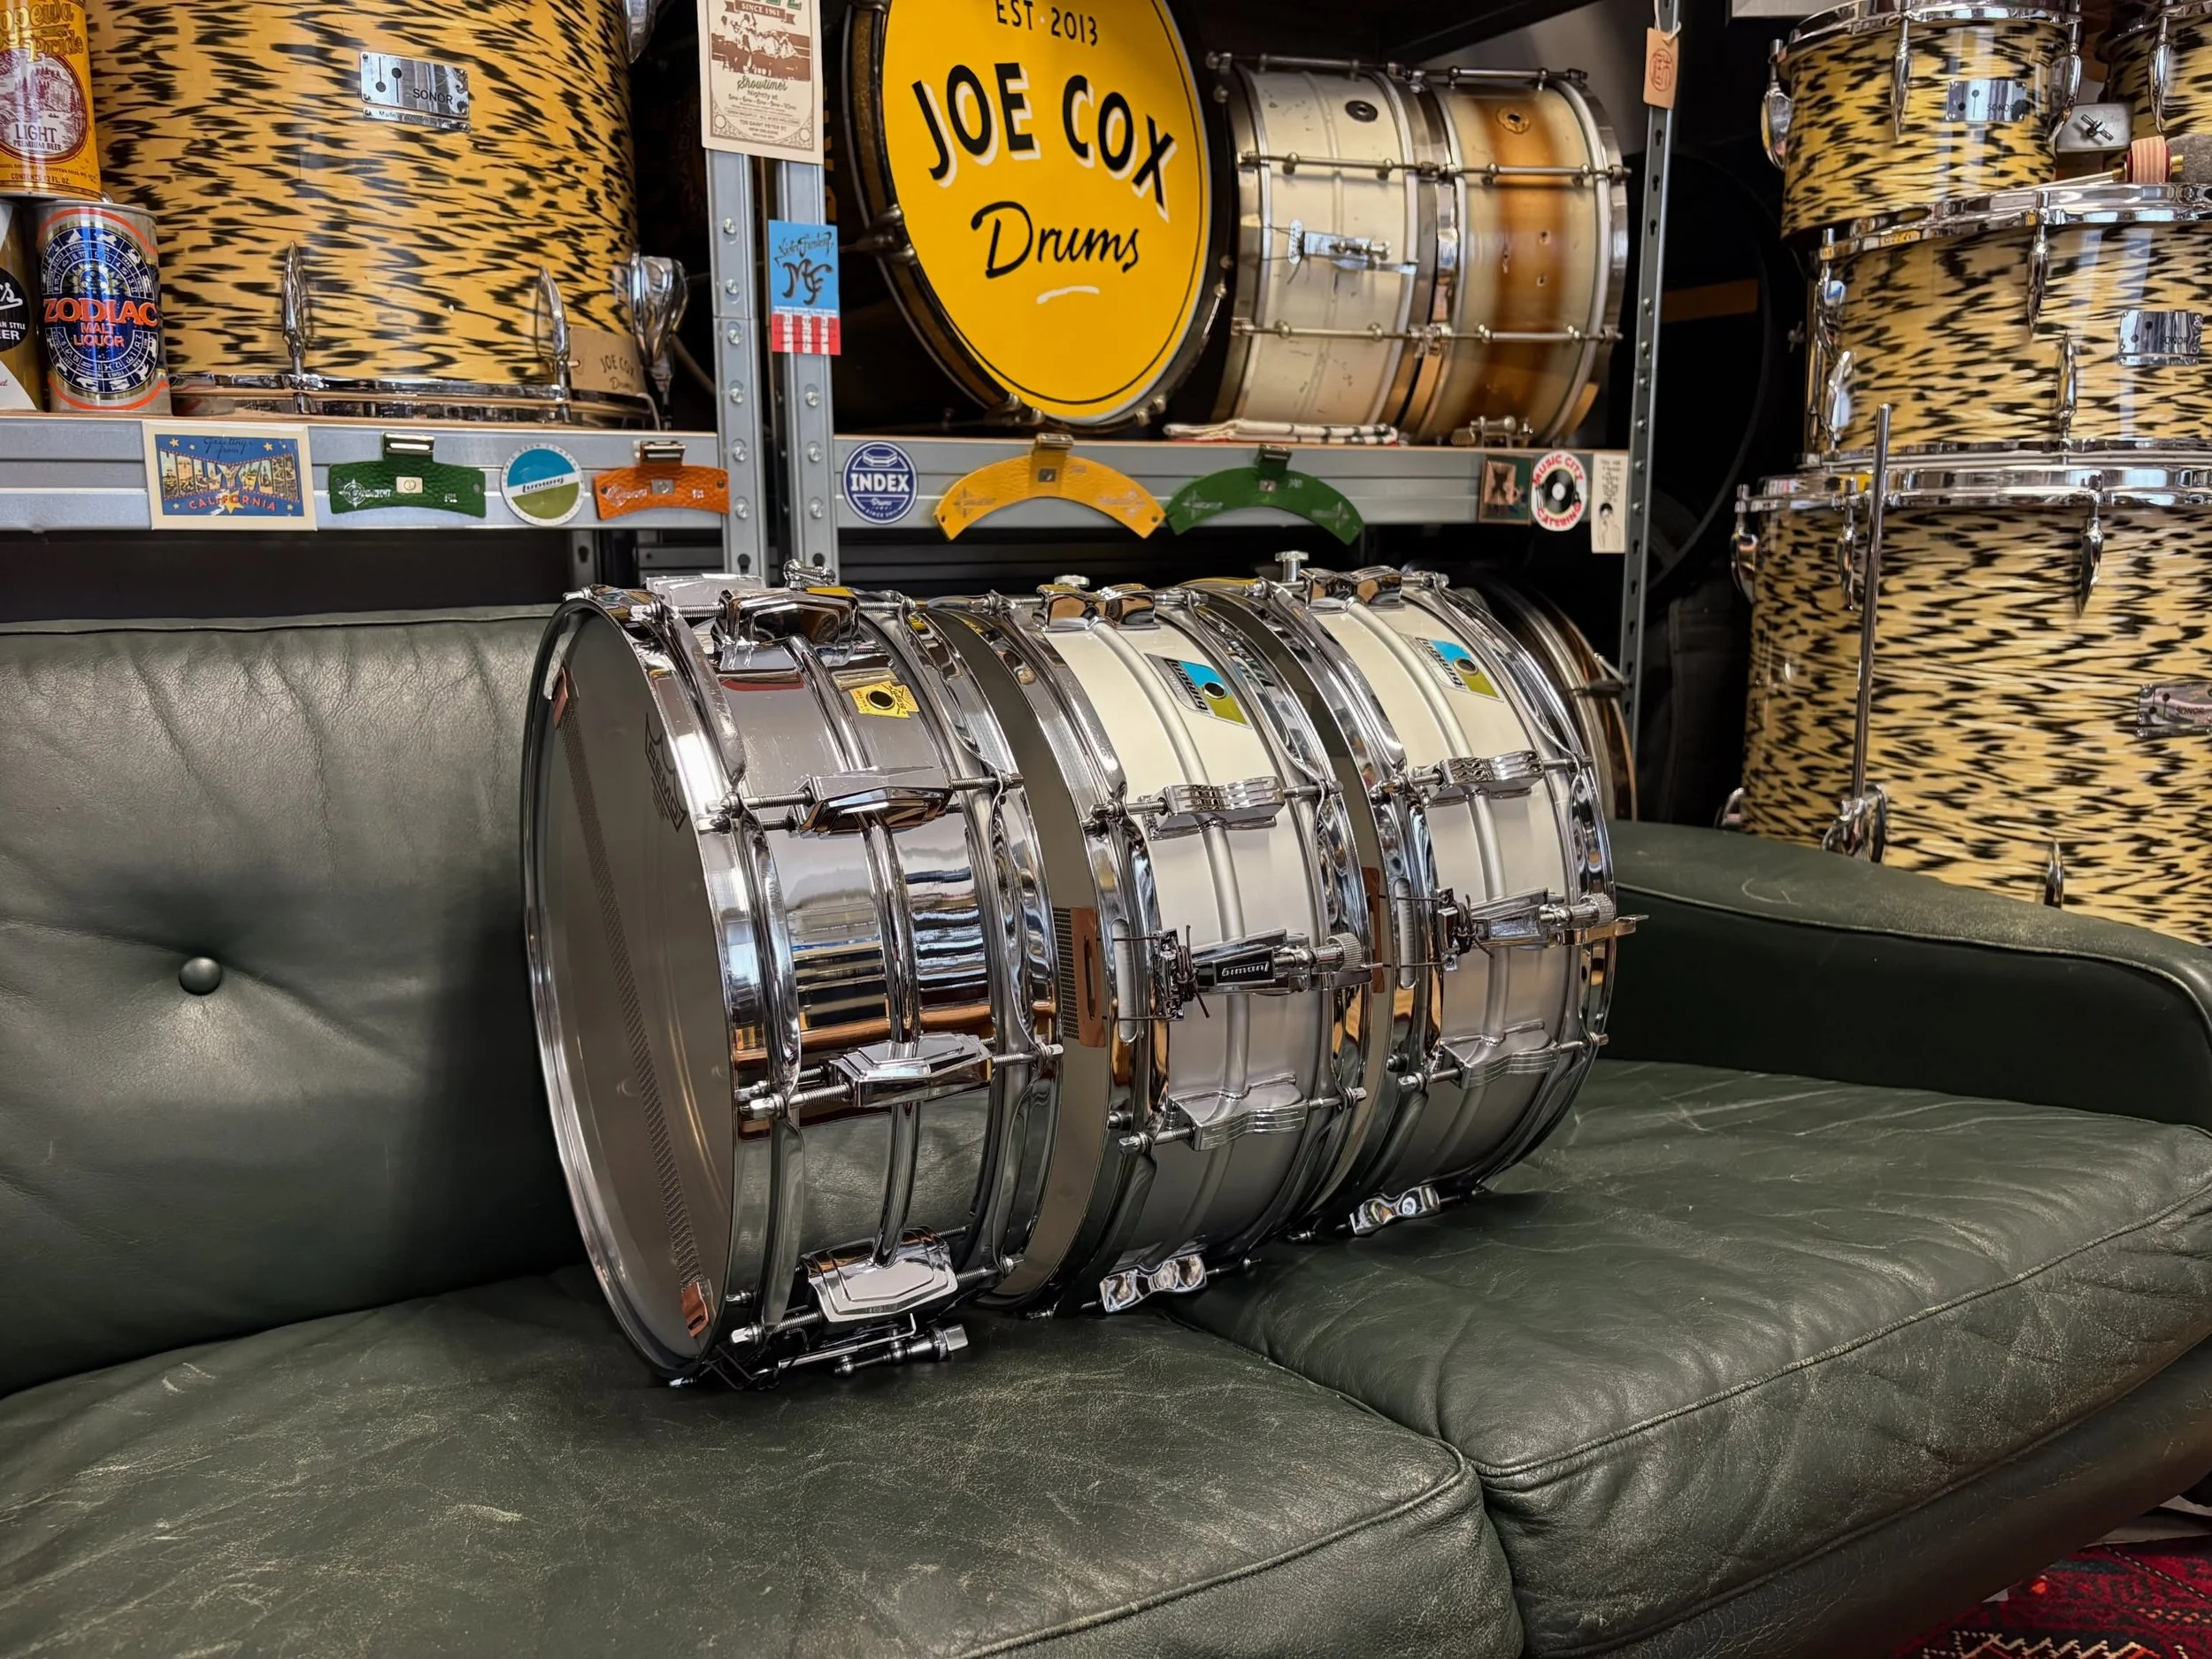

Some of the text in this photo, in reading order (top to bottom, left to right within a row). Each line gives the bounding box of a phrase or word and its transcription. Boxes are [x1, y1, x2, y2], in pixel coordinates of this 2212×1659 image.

[741, 4, 764, 13] SINCE
[995, 0, 1098, 46] EST 2013
[736, 75, 788, 91] Showtimes
[412, 88, 453, 104] SONOR
[15, 124, 58, 142] LIGHT
[13, 140, 45, 149] PREMIUM
[912, 63, 1177, 223] JOE COX
[11, 173, 42, 181] CONTENTS
[971, 201, 1140, 279] Drums
[43, 297, 158, 326] ZODIAC
[9, 321, 26, 330] STYLE
[81, 322, 116, 335] MALT
[73, 334, 125, 347] LIQUOR
[600, 354, 618, 373] JOE
[1532, 454, 1584, 486] MUSIC CITY
[850, 472, 910, 492] INDEX
[188, 493, 276, 511] CALIFORNIA
[648, 741, 680, 821] REMO
